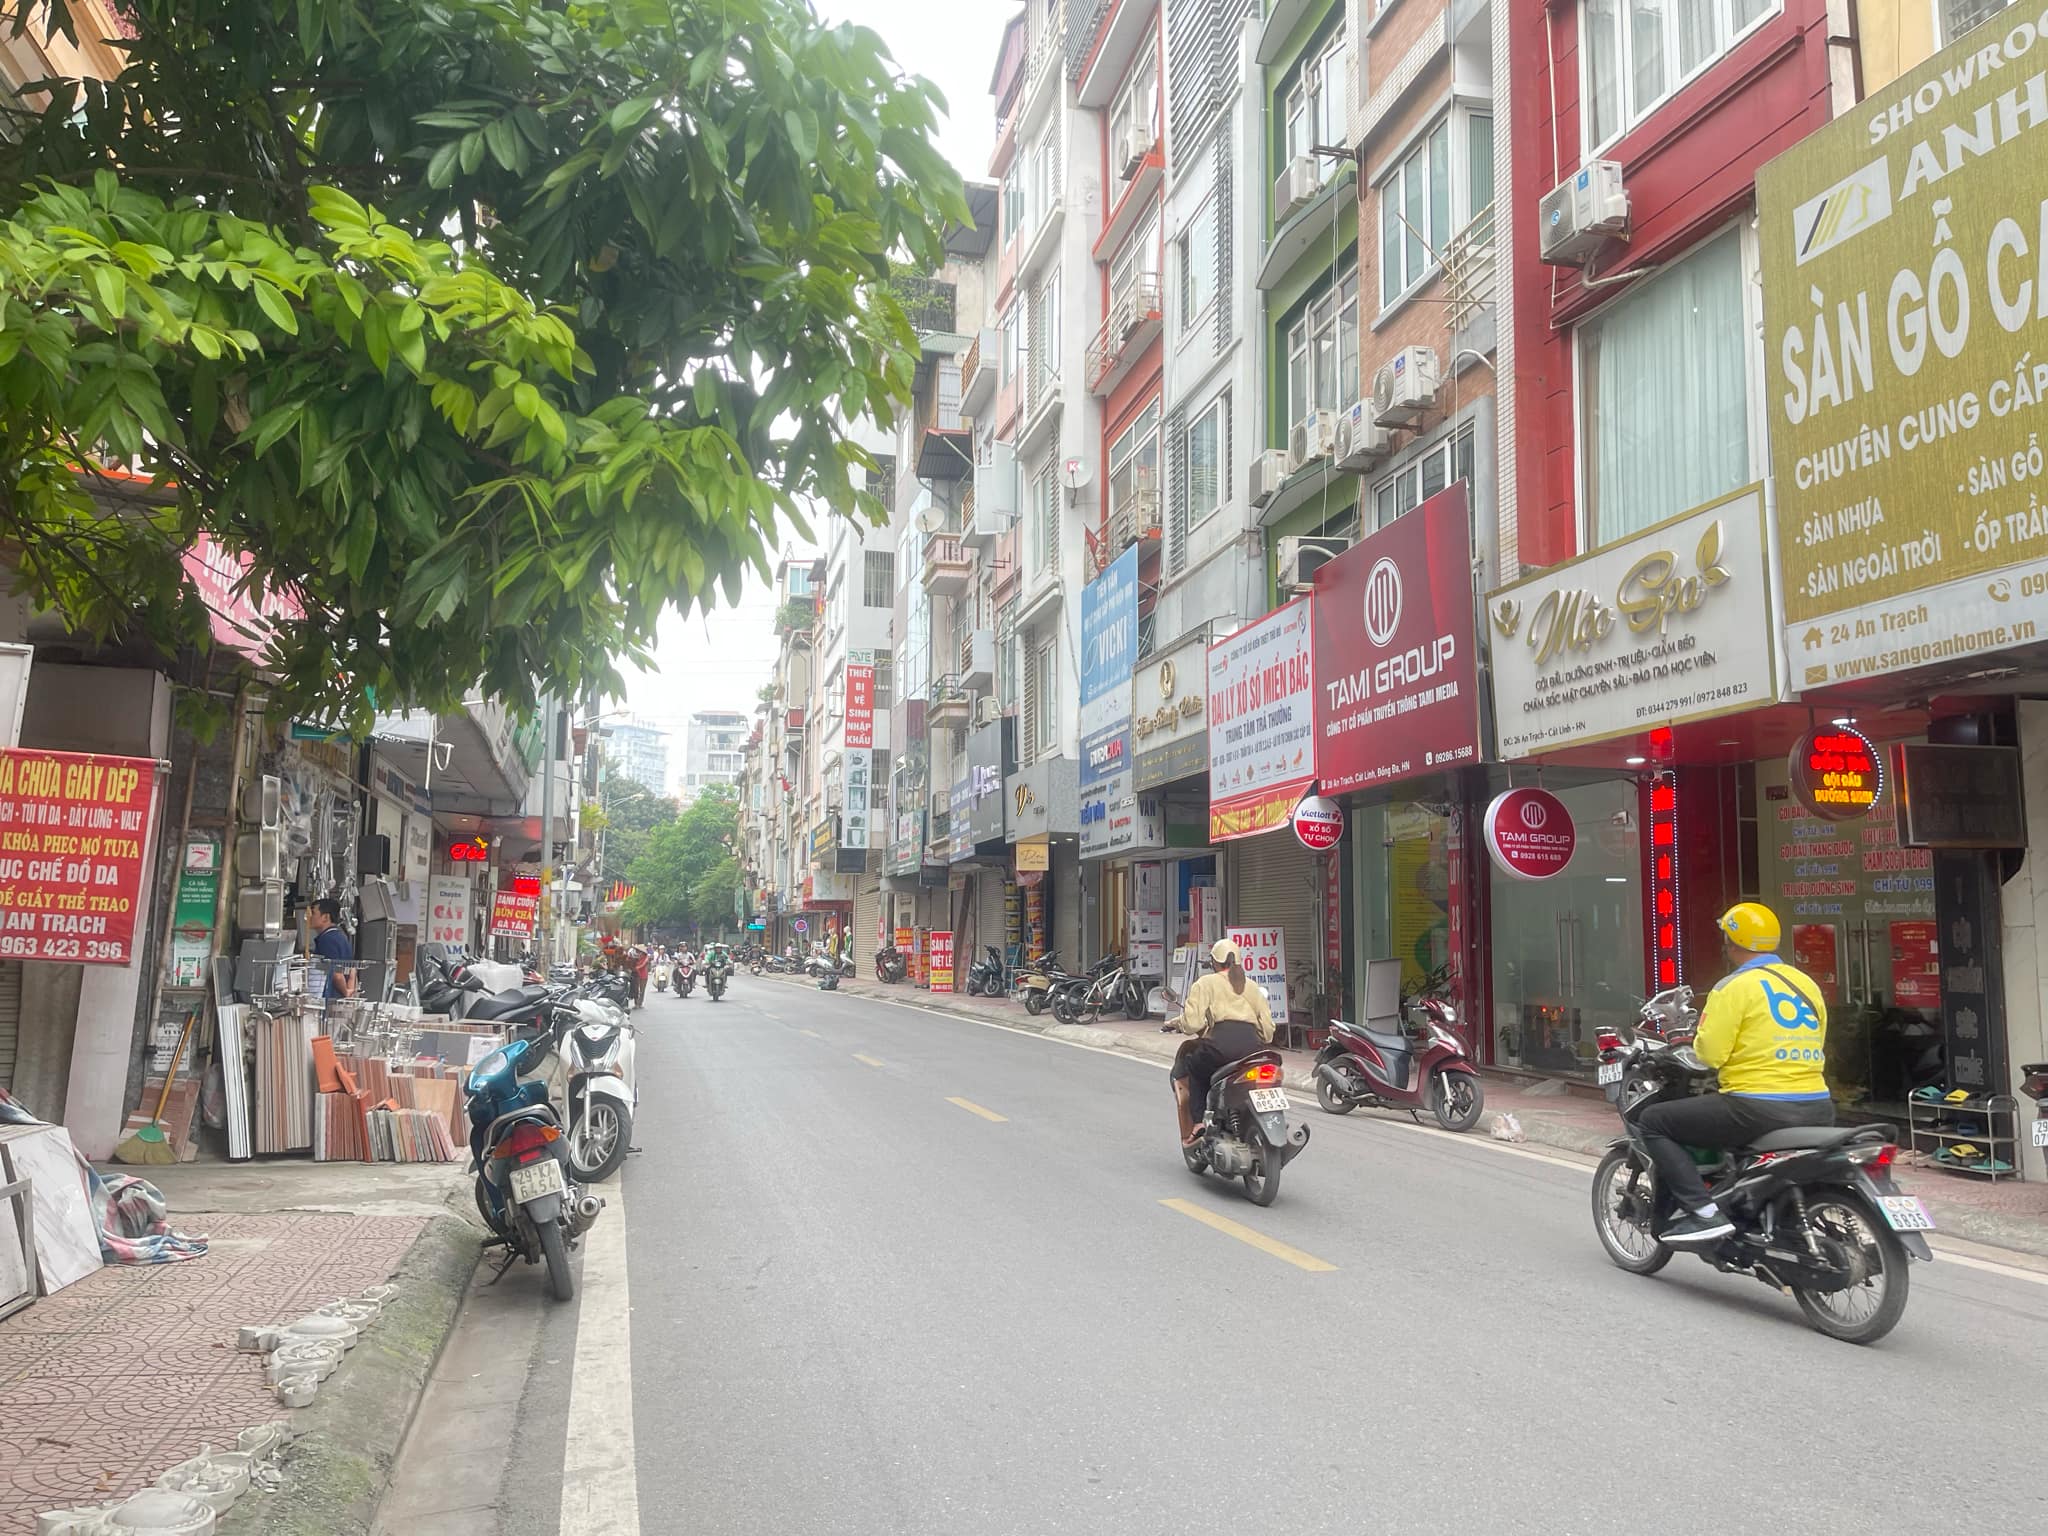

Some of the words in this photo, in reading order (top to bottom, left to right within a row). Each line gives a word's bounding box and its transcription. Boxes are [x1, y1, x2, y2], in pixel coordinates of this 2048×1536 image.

[1899, 70, 2048, 201] ANH
[1782, 284, 1874, 425] SÀN
[1887, 195, 1970, 377] GỖ
[1987, 199, 2048, 332] C
[1794, 423, 1891, 490] CHUYÊN
[1898, 392, 1980, 450] CUNG
[1988, 351, 2048, 417] CẤP
[1967, 455, 2007, 496] SÀN
[2011, 432, 2044, 482] GỖ
[1803, 511, 1834, 547] SÀN
[1838, 496, 1884, 536] NHỰA
[1974, 509, 2002, 553] ỐP
[1807, 562, 1839, 598] SÀN
[1842, 542, 1898, 588] NGOÀI
[1901, 529, 1942, 571] TRỜI
[2020, 571, 2048, 598] 09
[1527, 588, 1616, 666] Mộc
[1616, 550, 1707, 636] Spa
[1831, 622, 1850, 646] 24
[1855, 619, 1876, 640] An
[1880, 603, 1929, 633] Trạch
[1098, 615, 1127, 665] VICKI
[1834, 619, 2036, 680] www.sangoanhome.vn
[848, 667, 873, 678] THIẾT
[1327, 668, 1370, 711] TAMI
[1375, 633, 1455, 694] GROUP
[1535, 677, 1549, 693] GỘI
[1565, 664, 1594, 684] DƯỠNG
[1595, 658, 1613, 674] SINH
[1617, 655, 1630, 669] TRỊ
[1630, 648, 1648, 667] LIỆU
[1651, 637, 1676, 657] GIẢM
[1677, 634, 1696, 651] BÉO
[855, 682, 865, 693] BỊ
[1211, 689, 1224, 732] ĐẠI
[1225, 677, 1235, 722] LÝ
[1236, 663, 1248, 718] XỔ
[1249, 658, 1261, 712] SỐ
[1288, 639, 1309, 695] BẮC
[1523, 698, 1544, 713] CHĂM
[1546, 692, 1561, 707] SÓC
[1579, 680, 1611, 700] CHUYÊN
[1613, 673, 1629, 689] SÂU
[1632, 667, 1651, 685] ĐÀO
[1671, 659, 1692, 677] HỌC
[1694, 650, 1716, 667] VIÊN
[854, 695, 865, 706] VỆ
[1326, 720, 1341, 737] CÔNG
[1341, 719, 1348, 733] TY
[1397, 695, 1418, 715] THÔNG
[1418, 690, 1434, 708] TAMI
[1435, 680, 1459, 702] MEDIA
[1648, 702, 1665, 716] 0344
[1666, 698, 1679, 712] 279
[1716, 686, 1731, 700] 848
[1733, 682, 1748, 696] 823
[847, 720, 872, 732] NHẬP
[848, 708, 871, 718] SINH
[1225, 722, 1243, 745] TRUNG
[1243, 719, 1256, 739] TÂM
[1256, 710, 1267, 733] TRẢ
[1268, 703, 1292, 729] THƯỞNG
[847, 731, 871, 745] KHẨU
[1521, 733, 1529, 743] An
[1529, 730, 1544, 744] Trạch
[1576, 720, 1586, 732] HN
[1401, 760, 1410, 772] HN
[1435, 745, 1473, 764] 09286.15688
[18, 755, 62, 799] CHỮA
[105, 760, 139, 804] DÉP
[1823, 771, 1842, 789] GỘI
[1850, 789, 1874, 804] SINH
[21, 799, 37, 824] TÚI
[49, 805, 61, 826] DA
[120, 810, 142, 831] VALY
[1301, 809, 1331, 820] Vietlott
[1303, 833, 1314, 842] TỰ
[1315, 834, 1336, 844] CHỌN
[1309, 823, 1320, 833] XỔ
[1321, 825, 1332, 834] SỐ
[1500, 831, 1528, 842] TAMI
[1530, 833, 1571, 845] GROUP
[2, 829, 40, 852] KHÓA
[44, 834, 78, 855] PHEC
[80, 835, 102, 856] MƠ
[104, 838, 139, 859] TUYA
[1808, 842, 1832, 857] THANG
[27, 856, 65, 882] CHẾ
[95, 865, 119, 885] DA
[57, 887, 89, 911] THỂ
[89, 895, 130, 913] THAO
[1837, 879, 1856, 895] SINH
[6, 911, 36, 931] AN
[42, 913, 107, 937] TRẠCH
[495, 906, 513, 917] BÚN
[514, 907, 533, 921] CHẢ
[497, 918, 509, 929] GÀ
[0, 936, 38, 956] 963
[43, 937, 82, 958] 423
[85, 939, 123, 960] 396
[1233, 933, 1258, 951] ĐẠI
[1262, 929, 1278, 947] LÝ
[1240, 951, 1254, 971] Ổ
[1258, 950, 1278, 971] SỐ
[1760, 979, 1819, 1030] be
[2034, 1133, 2046, 1145] 07
[2037, 1121, 2048, 1134] 29
[1893, 1213, 1928, 1229] 6835
